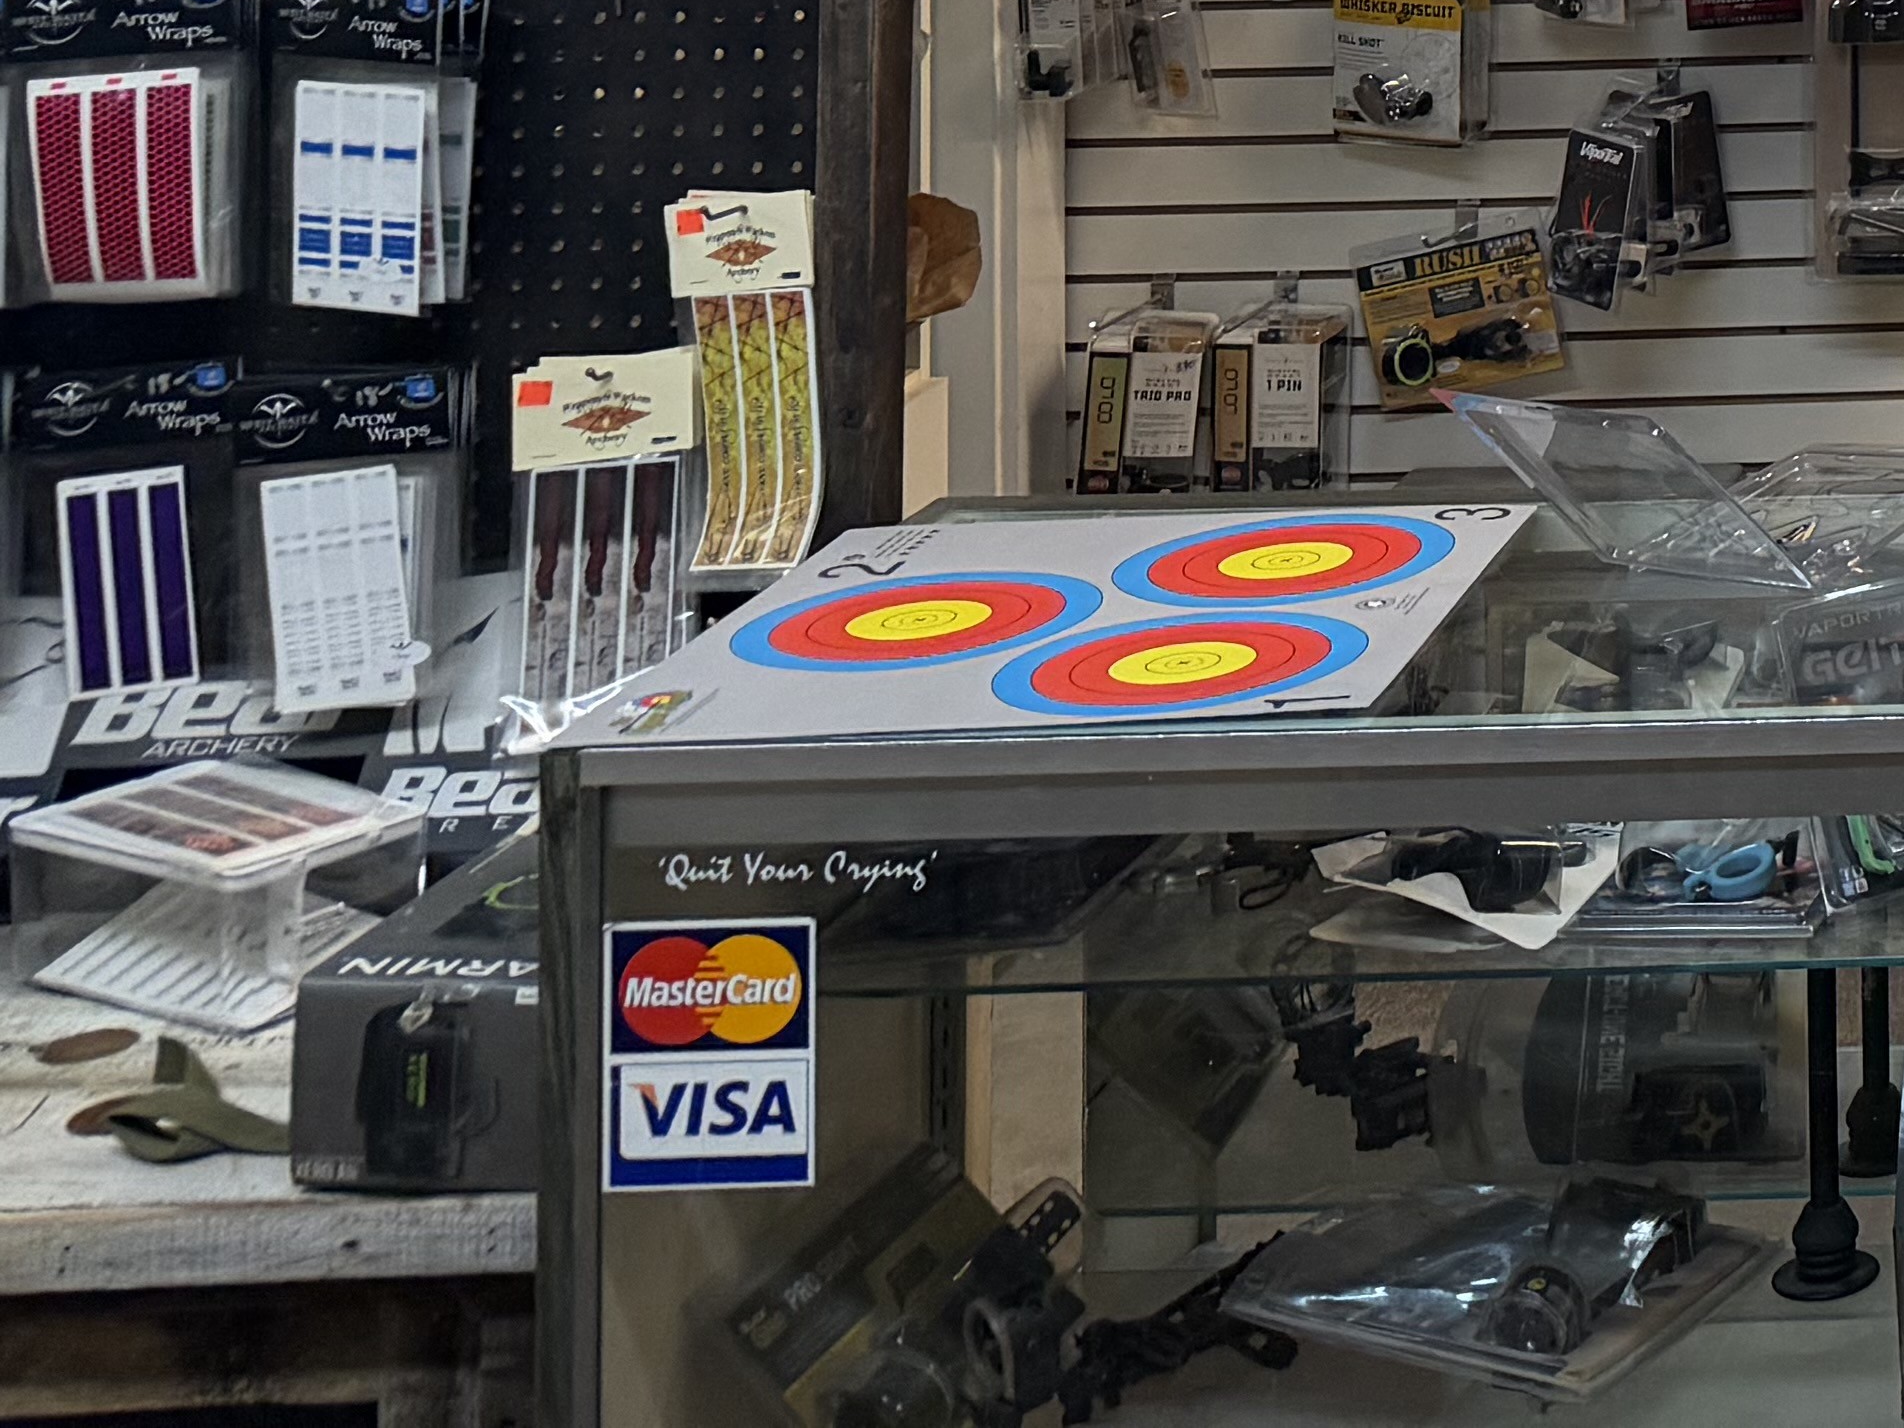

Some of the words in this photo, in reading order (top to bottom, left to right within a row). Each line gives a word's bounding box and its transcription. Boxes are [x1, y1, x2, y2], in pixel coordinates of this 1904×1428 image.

[111, 9, 179, 28] Arrow
[1399, 1, 1456, 20] BISCUIT
[147, 22, 214, 50] Wraps
[349, 16, 398, 34] Arrow
[372, 32, 422, 60] Wraps
[1414, 244, 1481, 277] RUSH
[1276, 379, 1302, 393] PIN
[124, 398, 187, 420] Arrow
[333, 411, 398, 431] Arrow
[157, 411, 221, 435] Wraps
[367, 423, 432, 448] Wraps
[142, 734, 299, 758] ARCHERY
[657, 853, 733, 890] 'Quit
[744, 854, 815, 885] Your
[625, 972, 797, 1009] MasterCard
[629, 1080, 797, 1137] VISA
